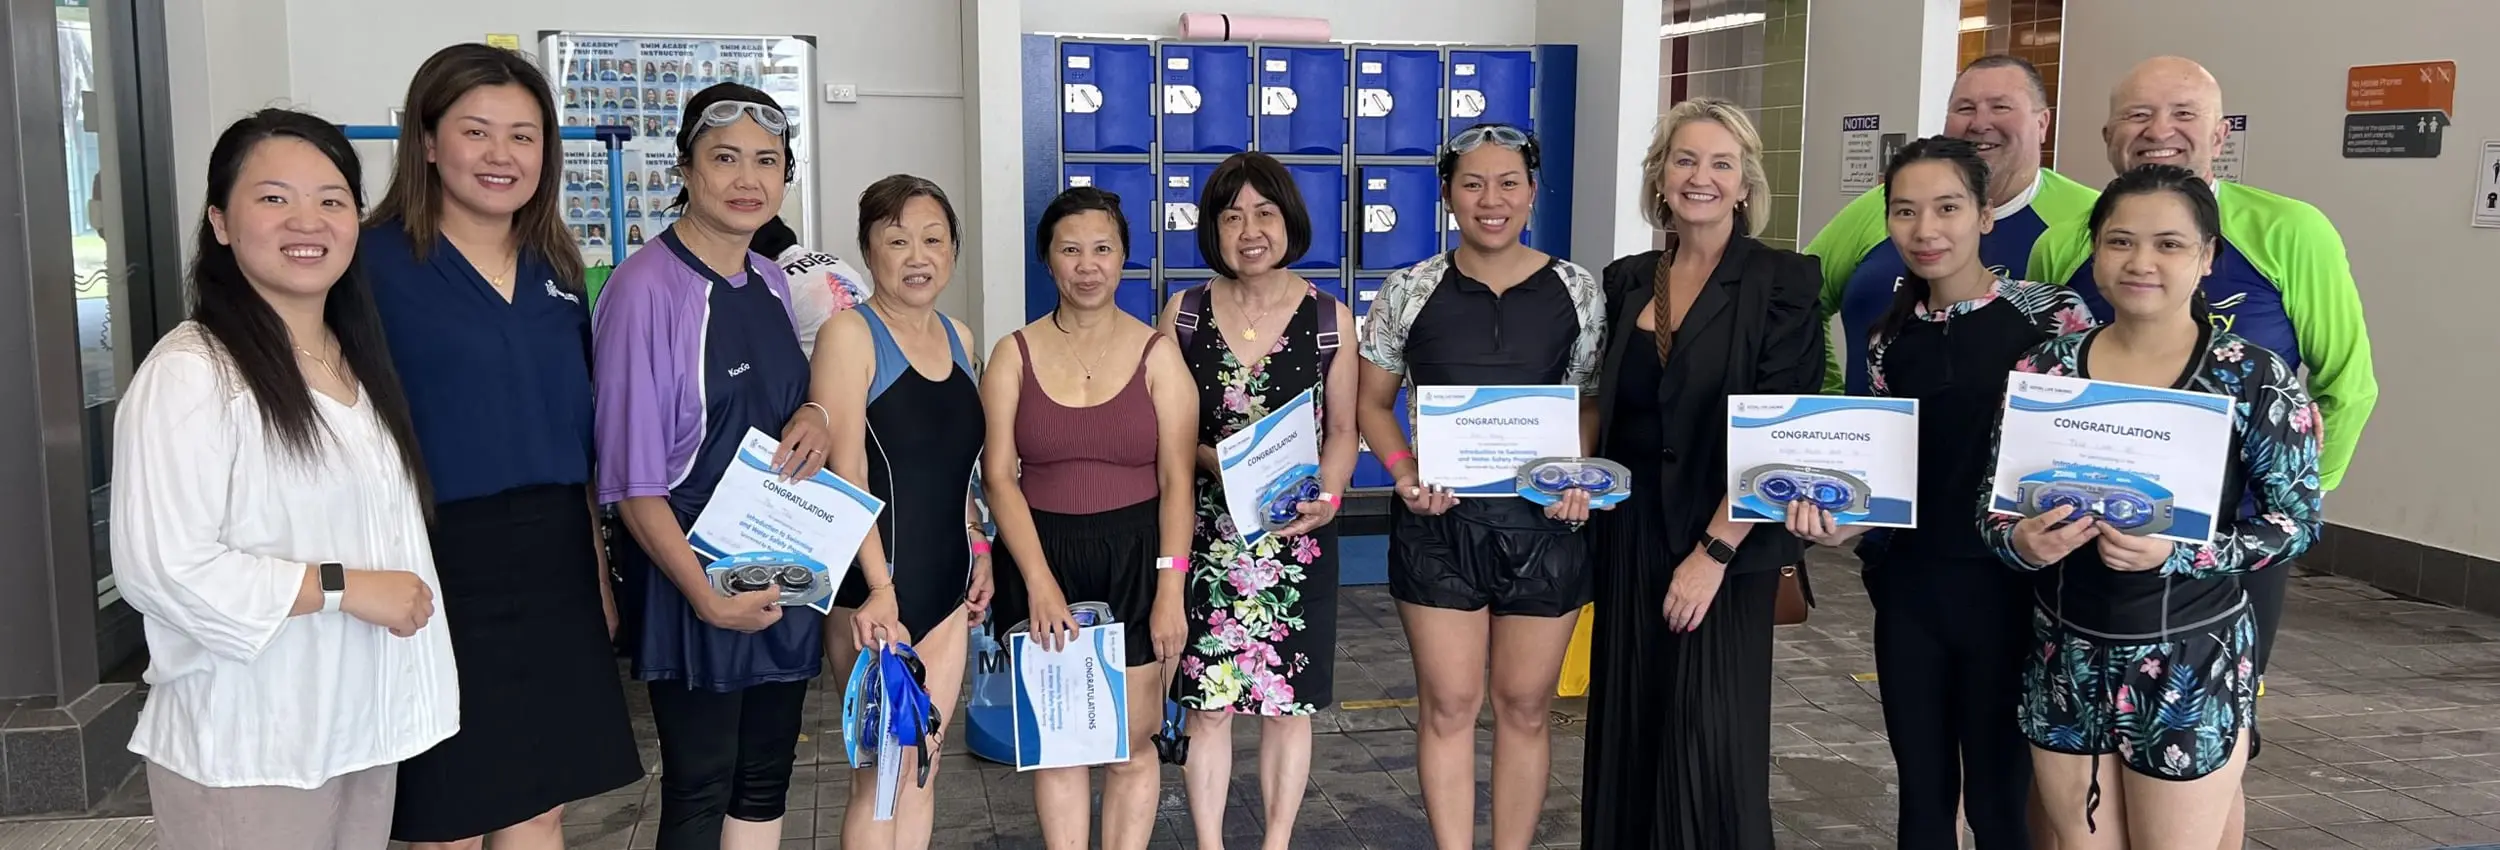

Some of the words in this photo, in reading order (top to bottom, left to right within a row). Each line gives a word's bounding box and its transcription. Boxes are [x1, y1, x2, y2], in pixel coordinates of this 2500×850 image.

[1844, 116, 1878, 129] NOTICE
[1456, 417, 1539, 426] CONGRATULATIONS
[2054, 418, 2171, 441] CONGRATULATIONS
[1771, 430, 1870, 442] CONGRATULATIONS
[1248, 431, 1298, 467] CONGRATULATIONS
[763, 479, 835, 523] CONGRATULATIONS
[1085, 656, 1097, 730] CONGRATULATIONS
